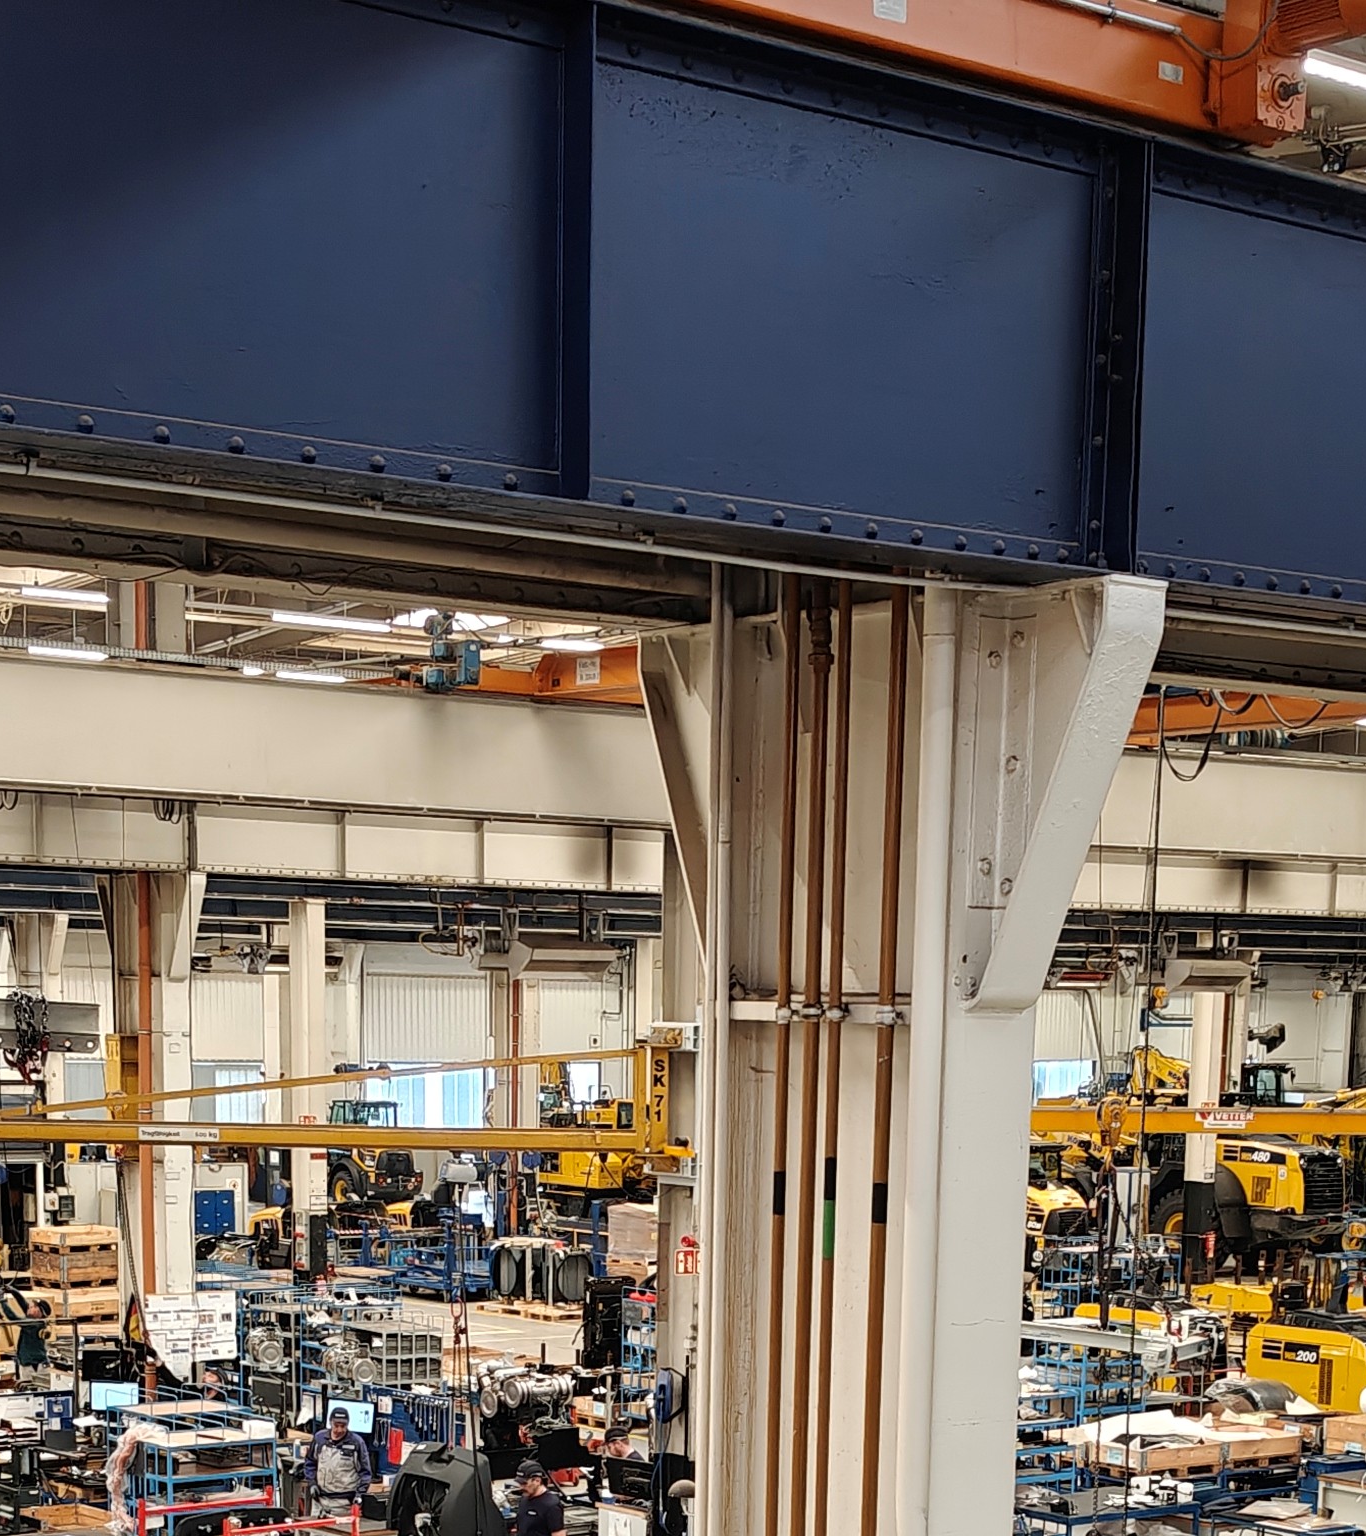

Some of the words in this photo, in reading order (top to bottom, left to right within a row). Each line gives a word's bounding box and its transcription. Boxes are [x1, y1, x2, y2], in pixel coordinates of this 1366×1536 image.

[653, 1059, 665, 1088] SK
[653, 1095, 664, 1122] 71
[1215, 1111, 1254, 1121] VETTER
[208, 1130, 218, 1139] kg
